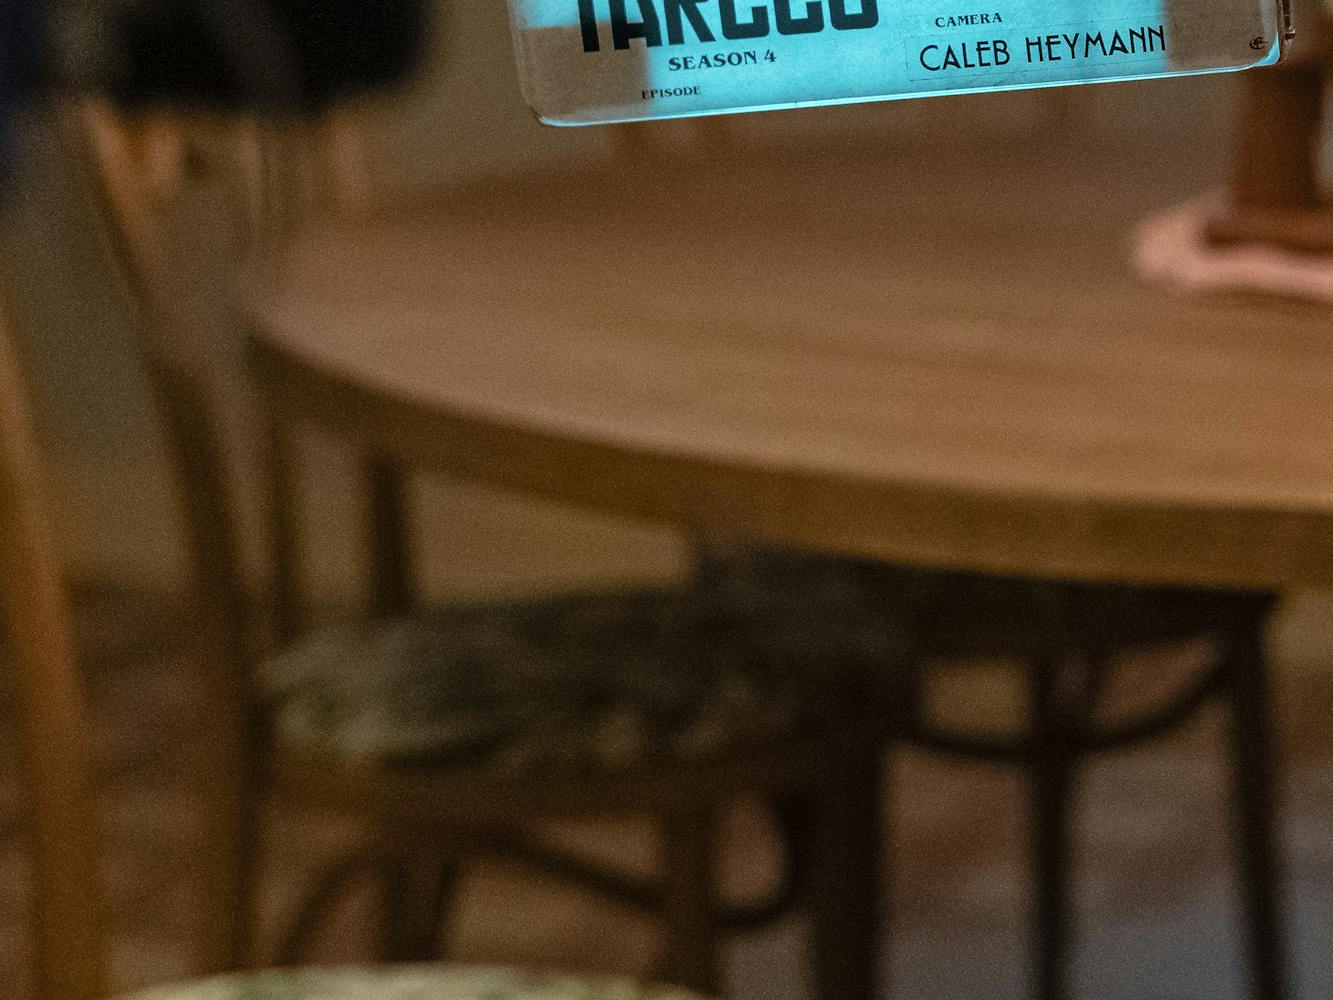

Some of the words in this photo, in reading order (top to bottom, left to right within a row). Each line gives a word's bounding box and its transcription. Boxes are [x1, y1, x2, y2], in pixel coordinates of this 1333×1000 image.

[934, 12, 1003, 28] CAMERA
[919, 39, 1011, 72] CALEB
[1025, 24, 1167, 63] HEYMANN
[668, 50, 758, 72] SEASON
[764, 49, 777, 63] 4
[641, 85, 701, 100] EPISODE
